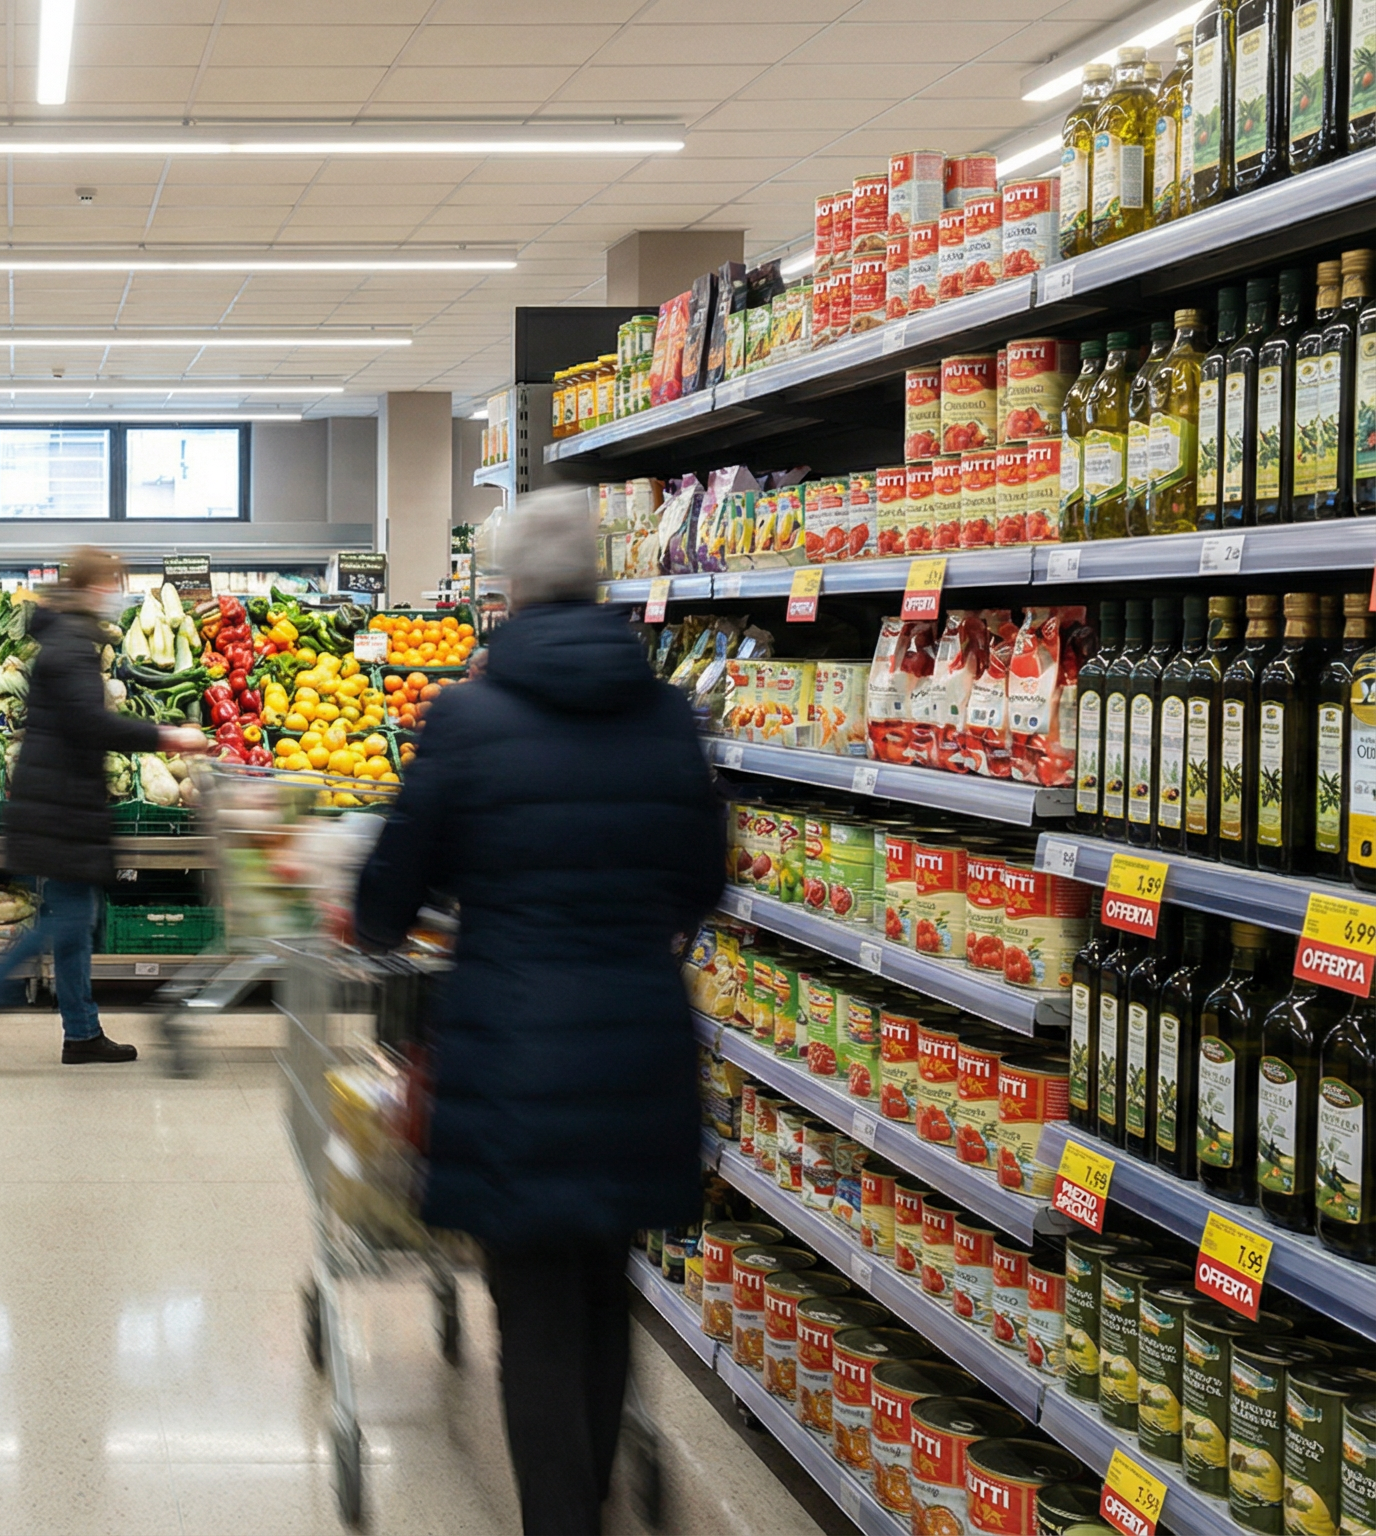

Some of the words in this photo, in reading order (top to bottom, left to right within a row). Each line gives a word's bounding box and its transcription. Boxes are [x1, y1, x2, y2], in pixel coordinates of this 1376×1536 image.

[1302, 948, 1365, 984] OFFERTA
[1199, 1263, 1253, 1307] OFFERTA
[966, 1470, 1009, 1509] UTTI
